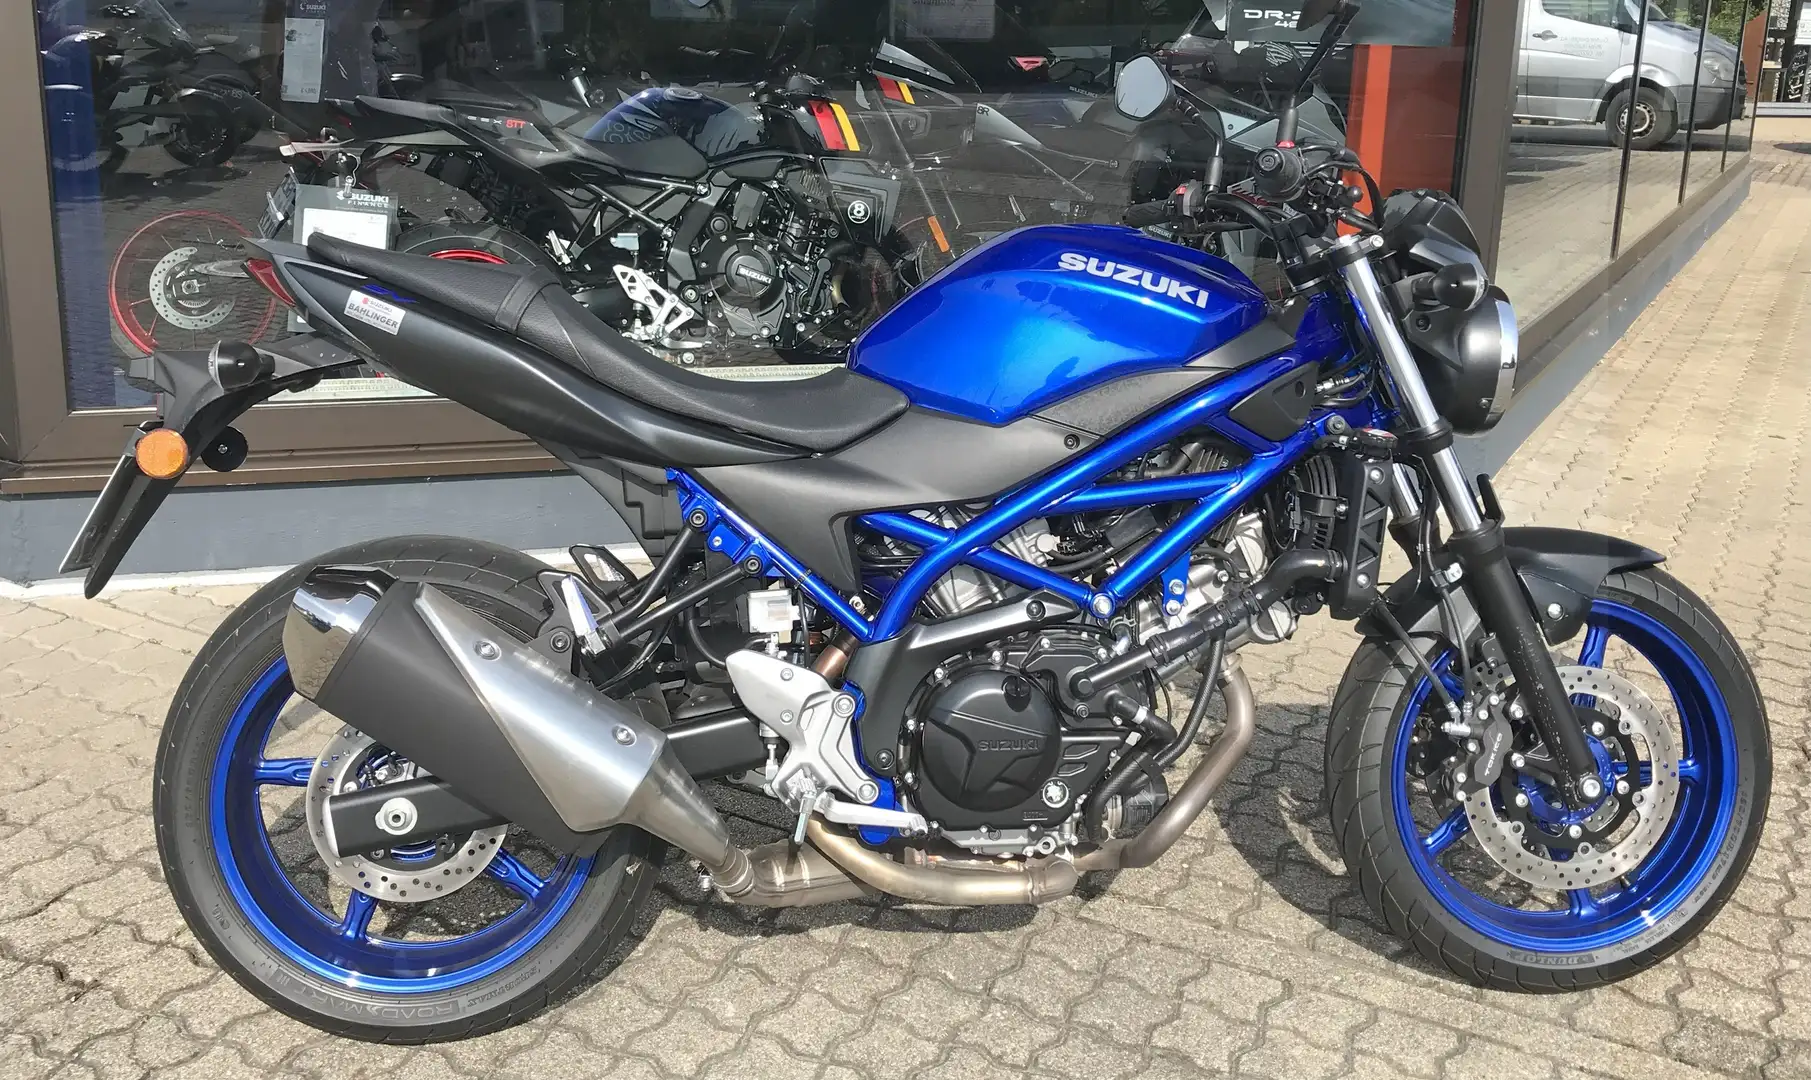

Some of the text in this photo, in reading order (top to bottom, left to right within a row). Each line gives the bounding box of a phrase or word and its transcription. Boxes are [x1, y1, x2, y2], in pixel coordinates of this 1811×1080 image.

[347, 200, 389, 208] FINANCE
[853, 203, 865, 217] 8
[738, 266, 772, 284] SUZUKI
[1058, 252, 1209, 309] SUZUKI
[347, 302, 399, 328] BAHLINGER
[979, 740, 1039, 752] SUZUKI
[1484, 732, 1503, 776] TOKICO
[1515, 953, 1579, 965] DUNLOP
